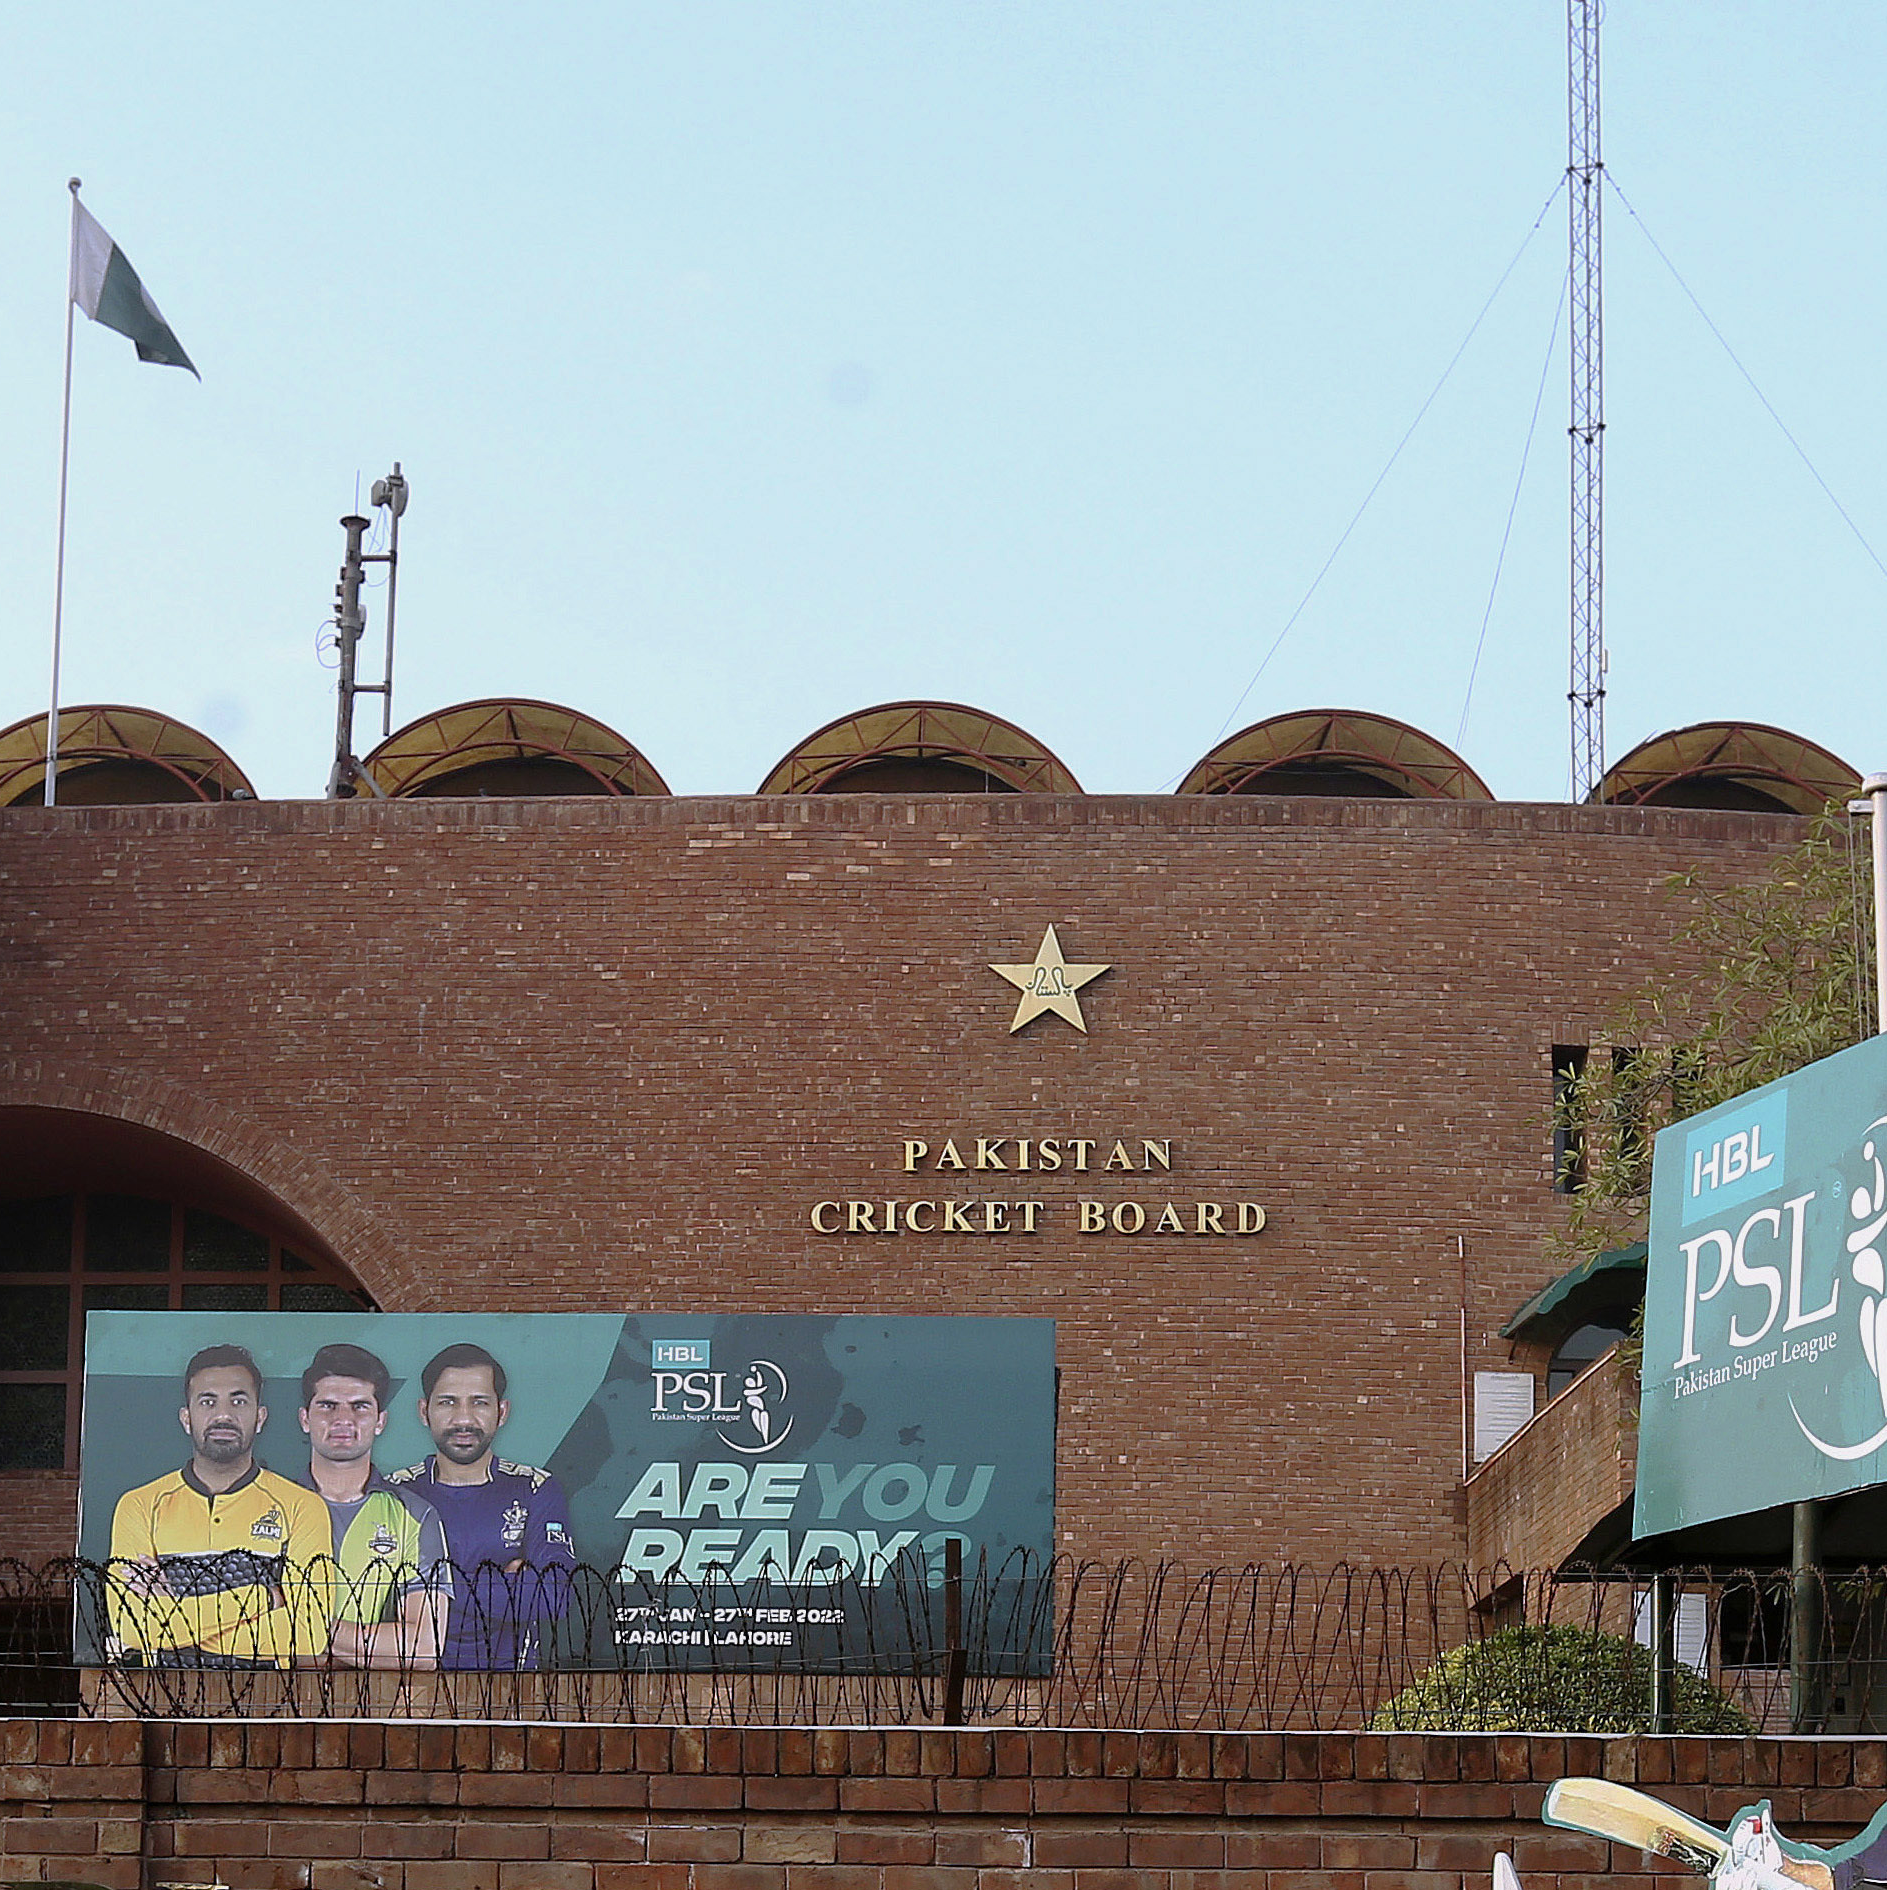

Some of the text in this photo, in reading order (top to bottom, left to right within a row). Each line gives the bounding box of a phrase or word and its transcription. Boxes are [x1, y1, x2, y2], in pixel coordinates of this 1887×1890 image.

[901, 1138, 1173, 1173] PAKISTAN
[1691, 1123, 1775, 1198] HBL
[809, 1200, 1268, 1235] CRICKET BOARD
[1673, 1190, 1841, 1371] PSL
[657, 1346, 704, 1362] HBL
[1673, 1330, 1838, 1400] Pakistan Super League
[650, 1372, 742, 1412] PSL
[652, 1412, 741, 1424] Pakistan Super League
[614, 1461, 997, 1523] ARE YOU
[755, 1608, 793, 1624] FEB
[796, 1608, 845, 1624] 2022
[615, 1630, 701, 1647] KARACHI
[713, 1630, 793, 1647] LAHORE
